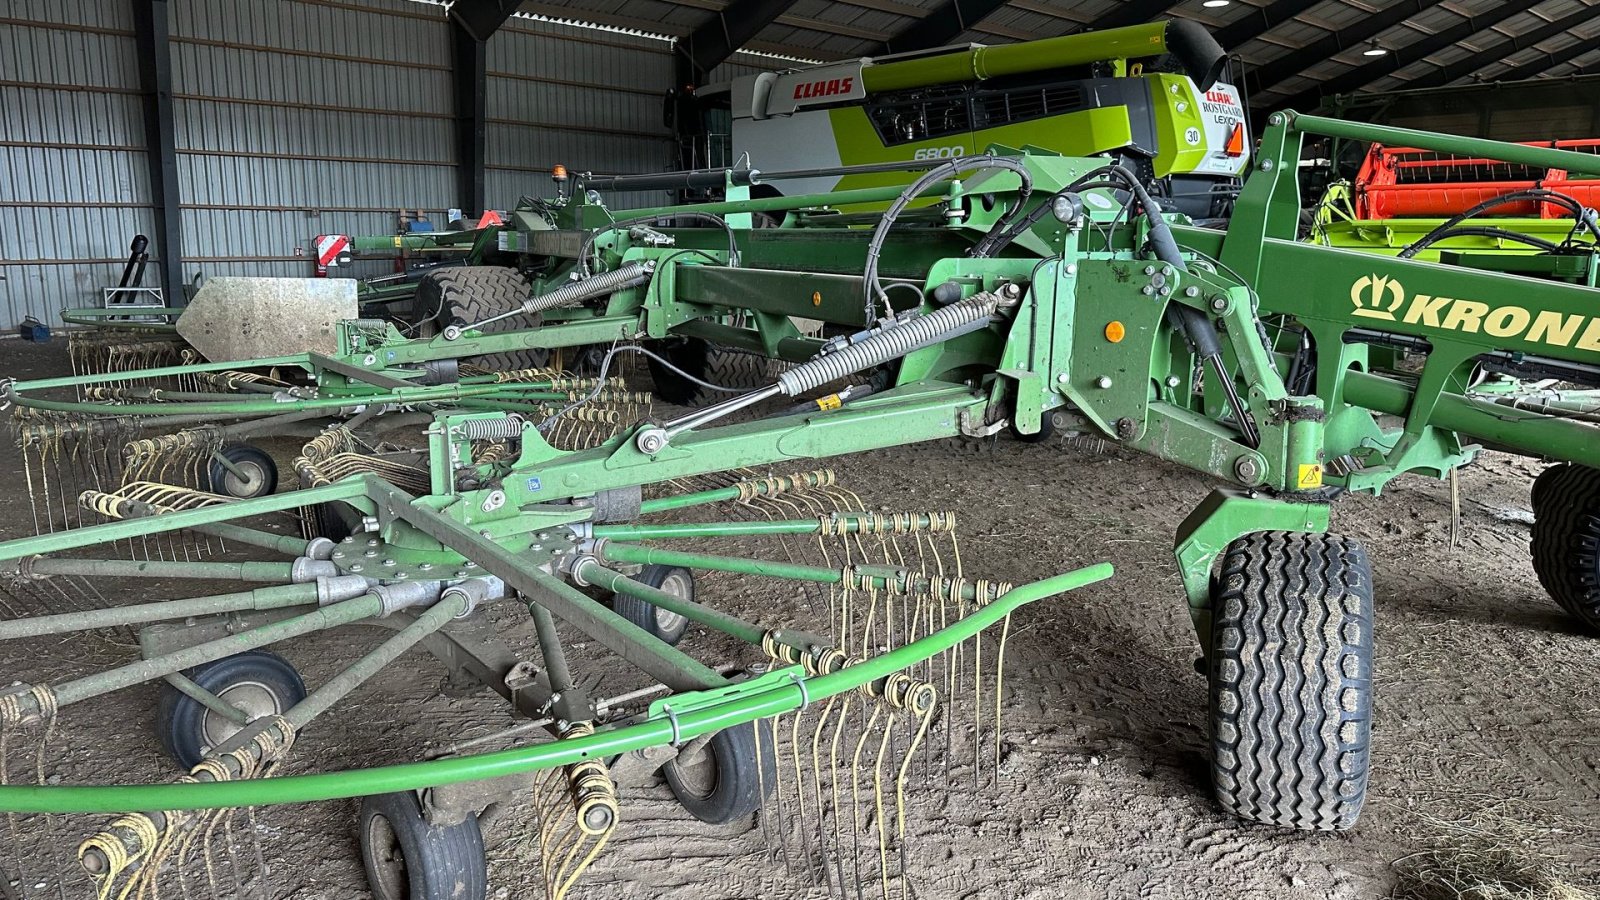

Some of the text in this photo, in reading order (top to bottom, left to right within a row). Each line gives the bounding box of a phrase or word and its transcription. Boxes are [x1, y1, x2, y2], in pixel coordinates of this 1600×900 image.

[793, 77, 853, 99] CLAAS
[1187, 130, 1198, 142] 30
[914, 145, 964, 160] 6800
